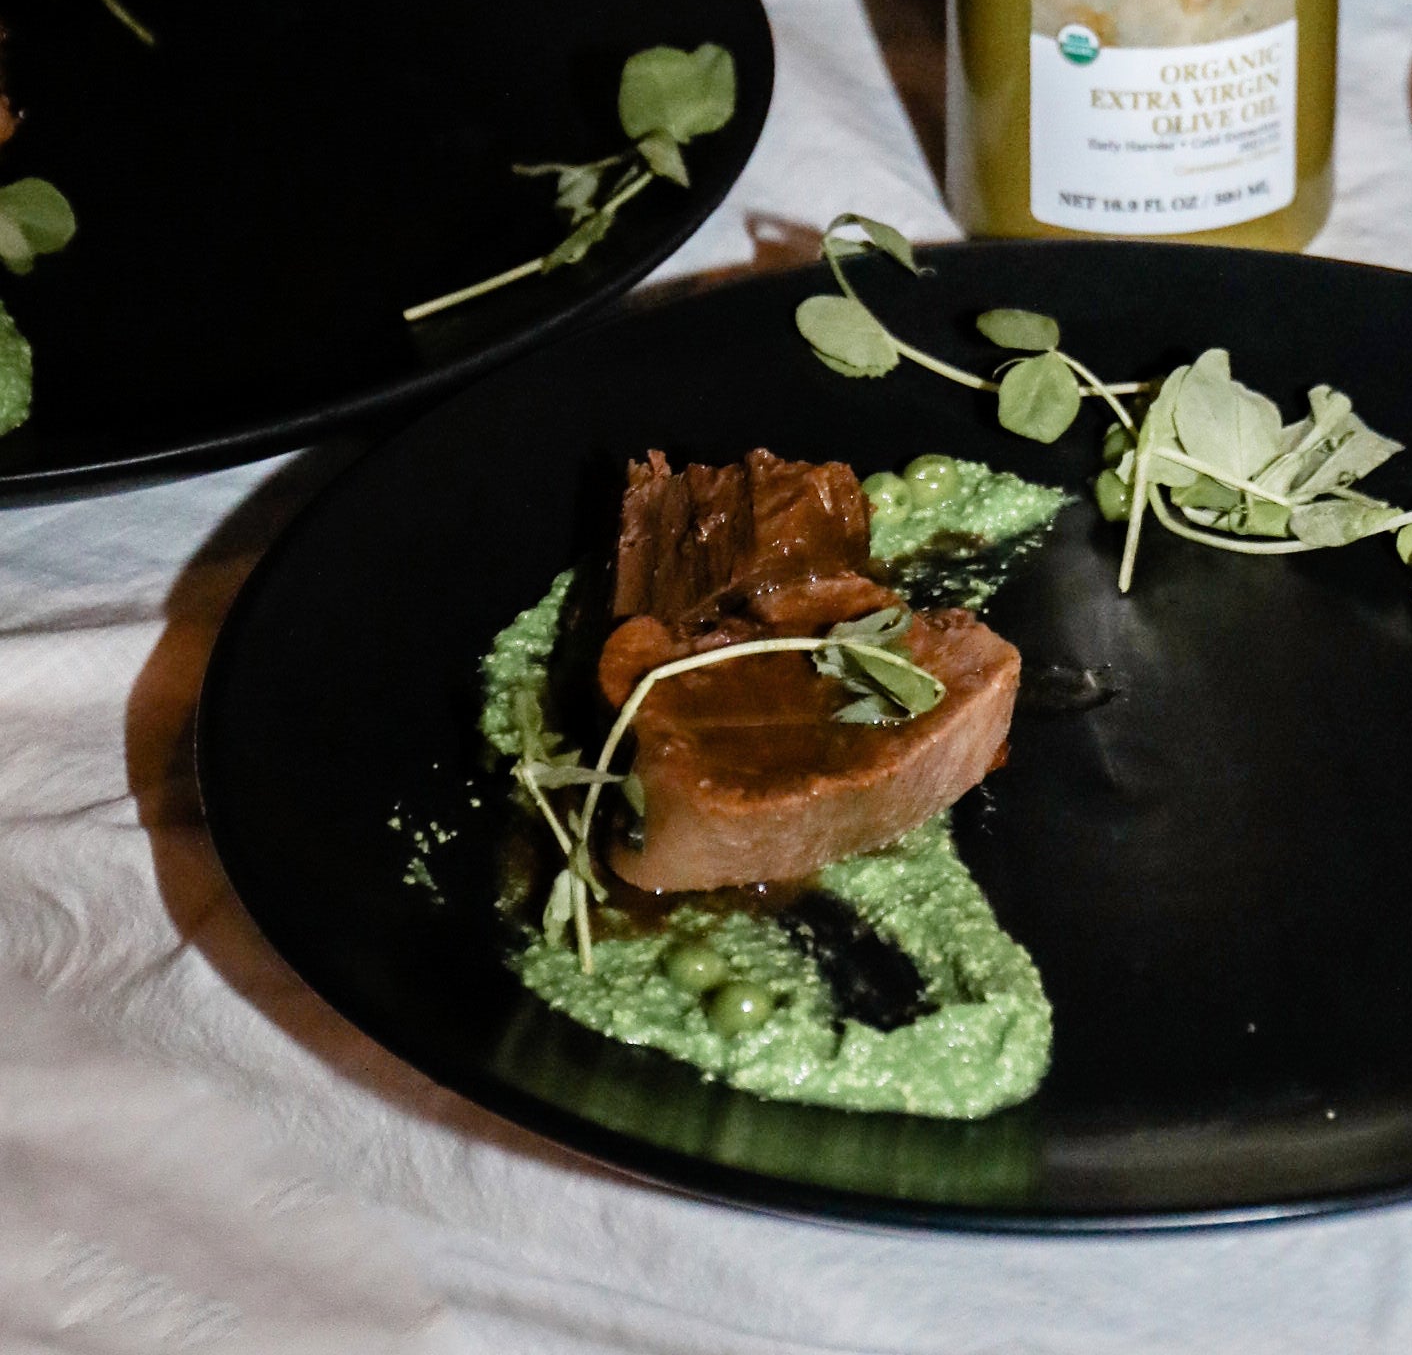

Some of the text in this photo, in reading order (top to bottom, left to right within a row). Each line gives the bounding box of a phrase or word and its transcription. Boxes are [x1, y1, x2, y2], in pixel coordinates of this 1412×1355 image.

[1160, 42, 1281, 84] ORGANIC
[1089, 71, 1280, 111] EXTRA VIRGIN
[1151, 109, 1233, 136] OLIVE
[1240, 95, 1278, 123] OIL
[1058, 191, 1097, 209] NET
[1103, 198, 1138, 213] 16.9
[1144, 197, 1166, 212] FL
[1171, 195, 1199, 210] OZ
